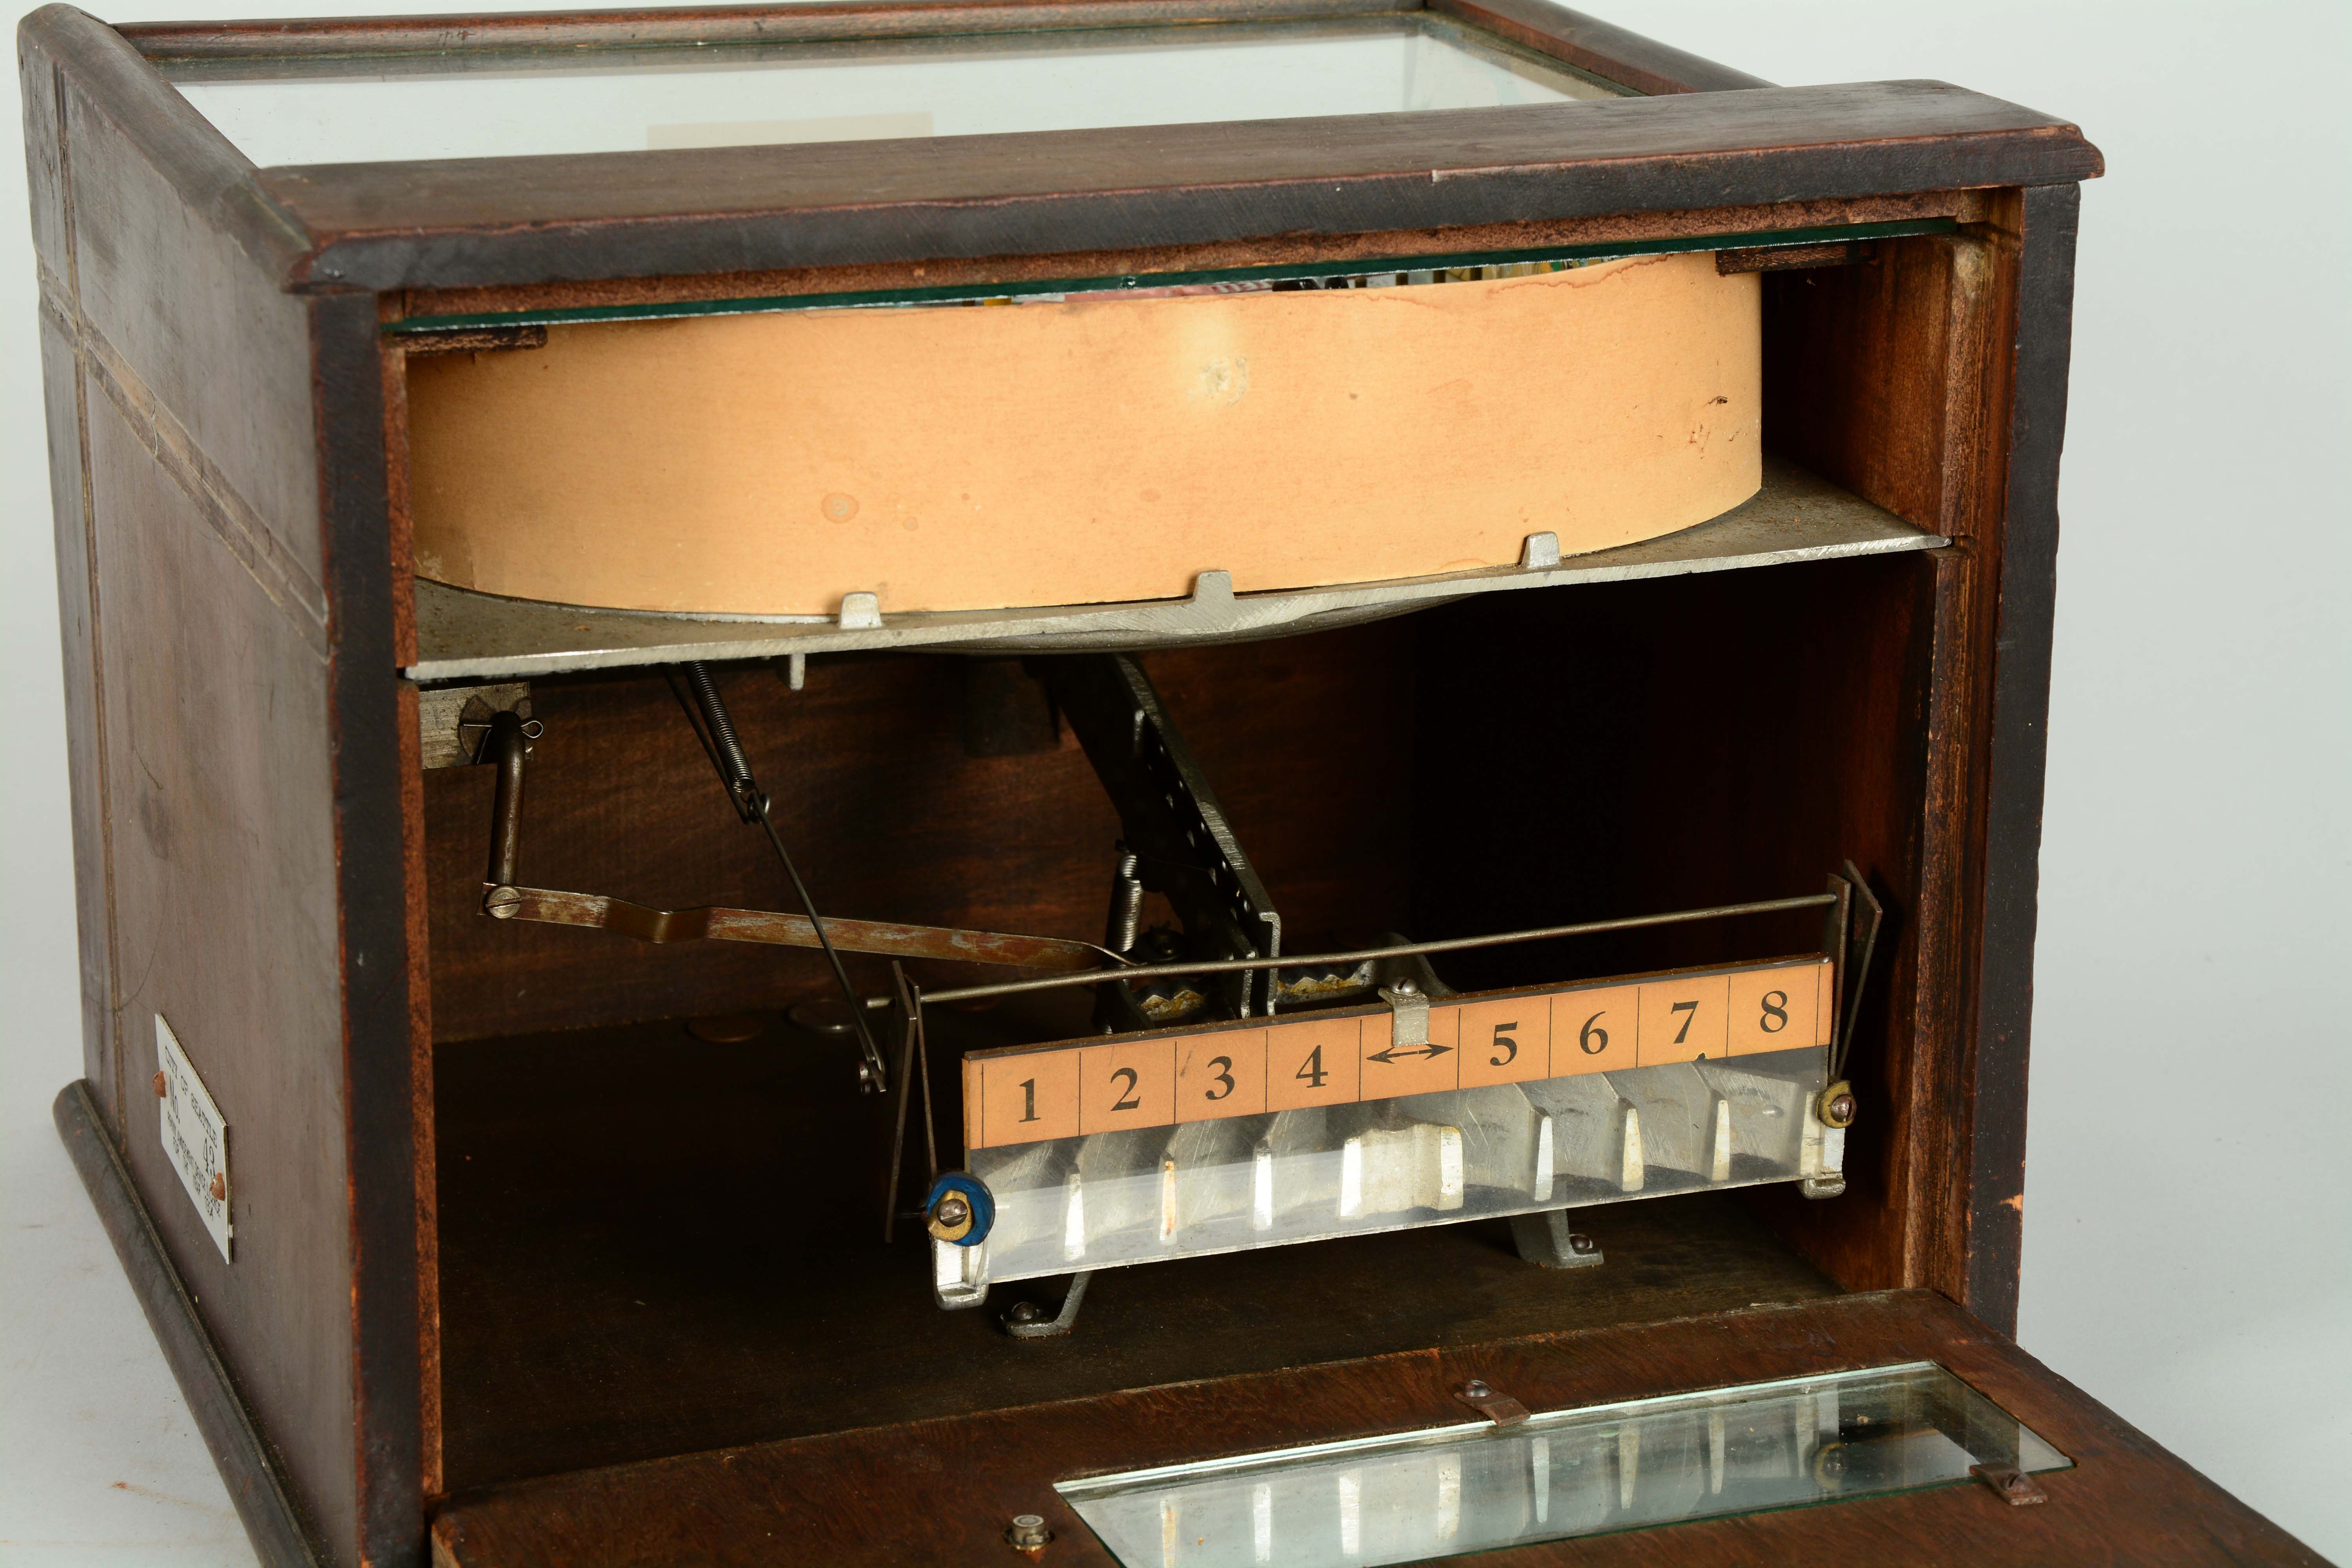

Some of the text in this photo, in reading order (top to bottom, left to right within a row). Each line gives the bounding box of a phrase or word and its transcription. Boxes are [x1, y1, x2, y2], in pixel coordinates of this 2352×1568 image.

[165, 1045, 217, 1148] CITY OF SEATTLE
[1019, 990, 1788, 1123] 1 2 3 4 5 6 7 8
[169, 1075, 215, 1179] No. 43
